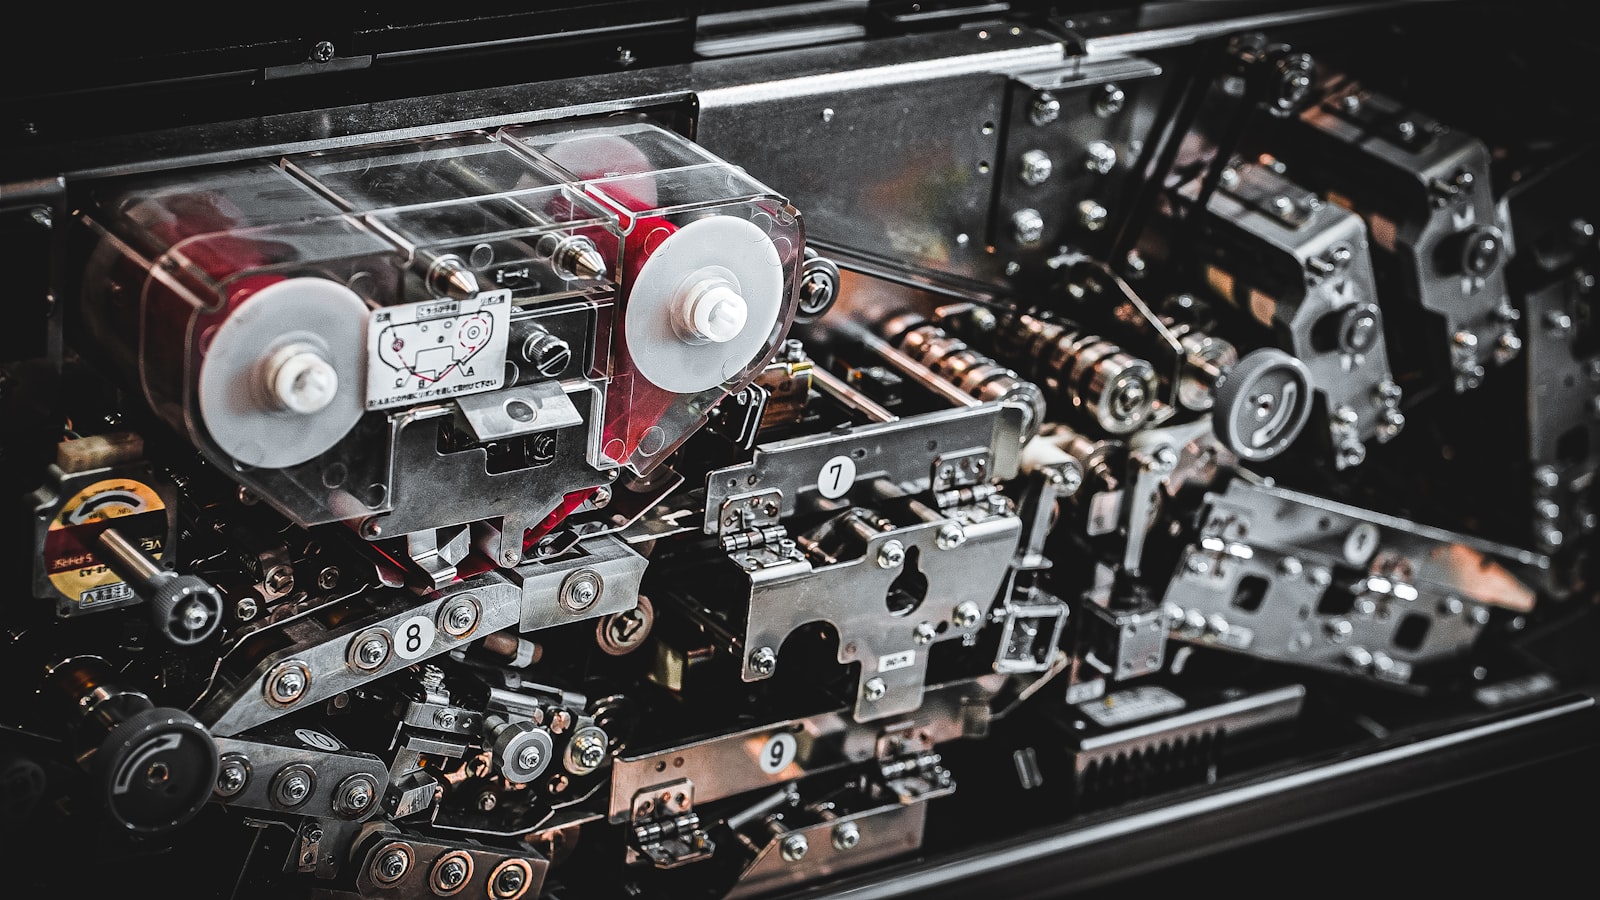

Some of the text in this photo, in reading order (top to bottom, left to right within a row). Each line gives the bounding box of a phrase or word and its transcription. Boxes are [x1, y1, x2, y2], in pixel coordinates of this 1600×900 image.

[829, 463, 842, 490] 7
[406, 623, 421, 652] 8
[299, 731, 333, 748] 10
[770, 740, 784, 767] 9
